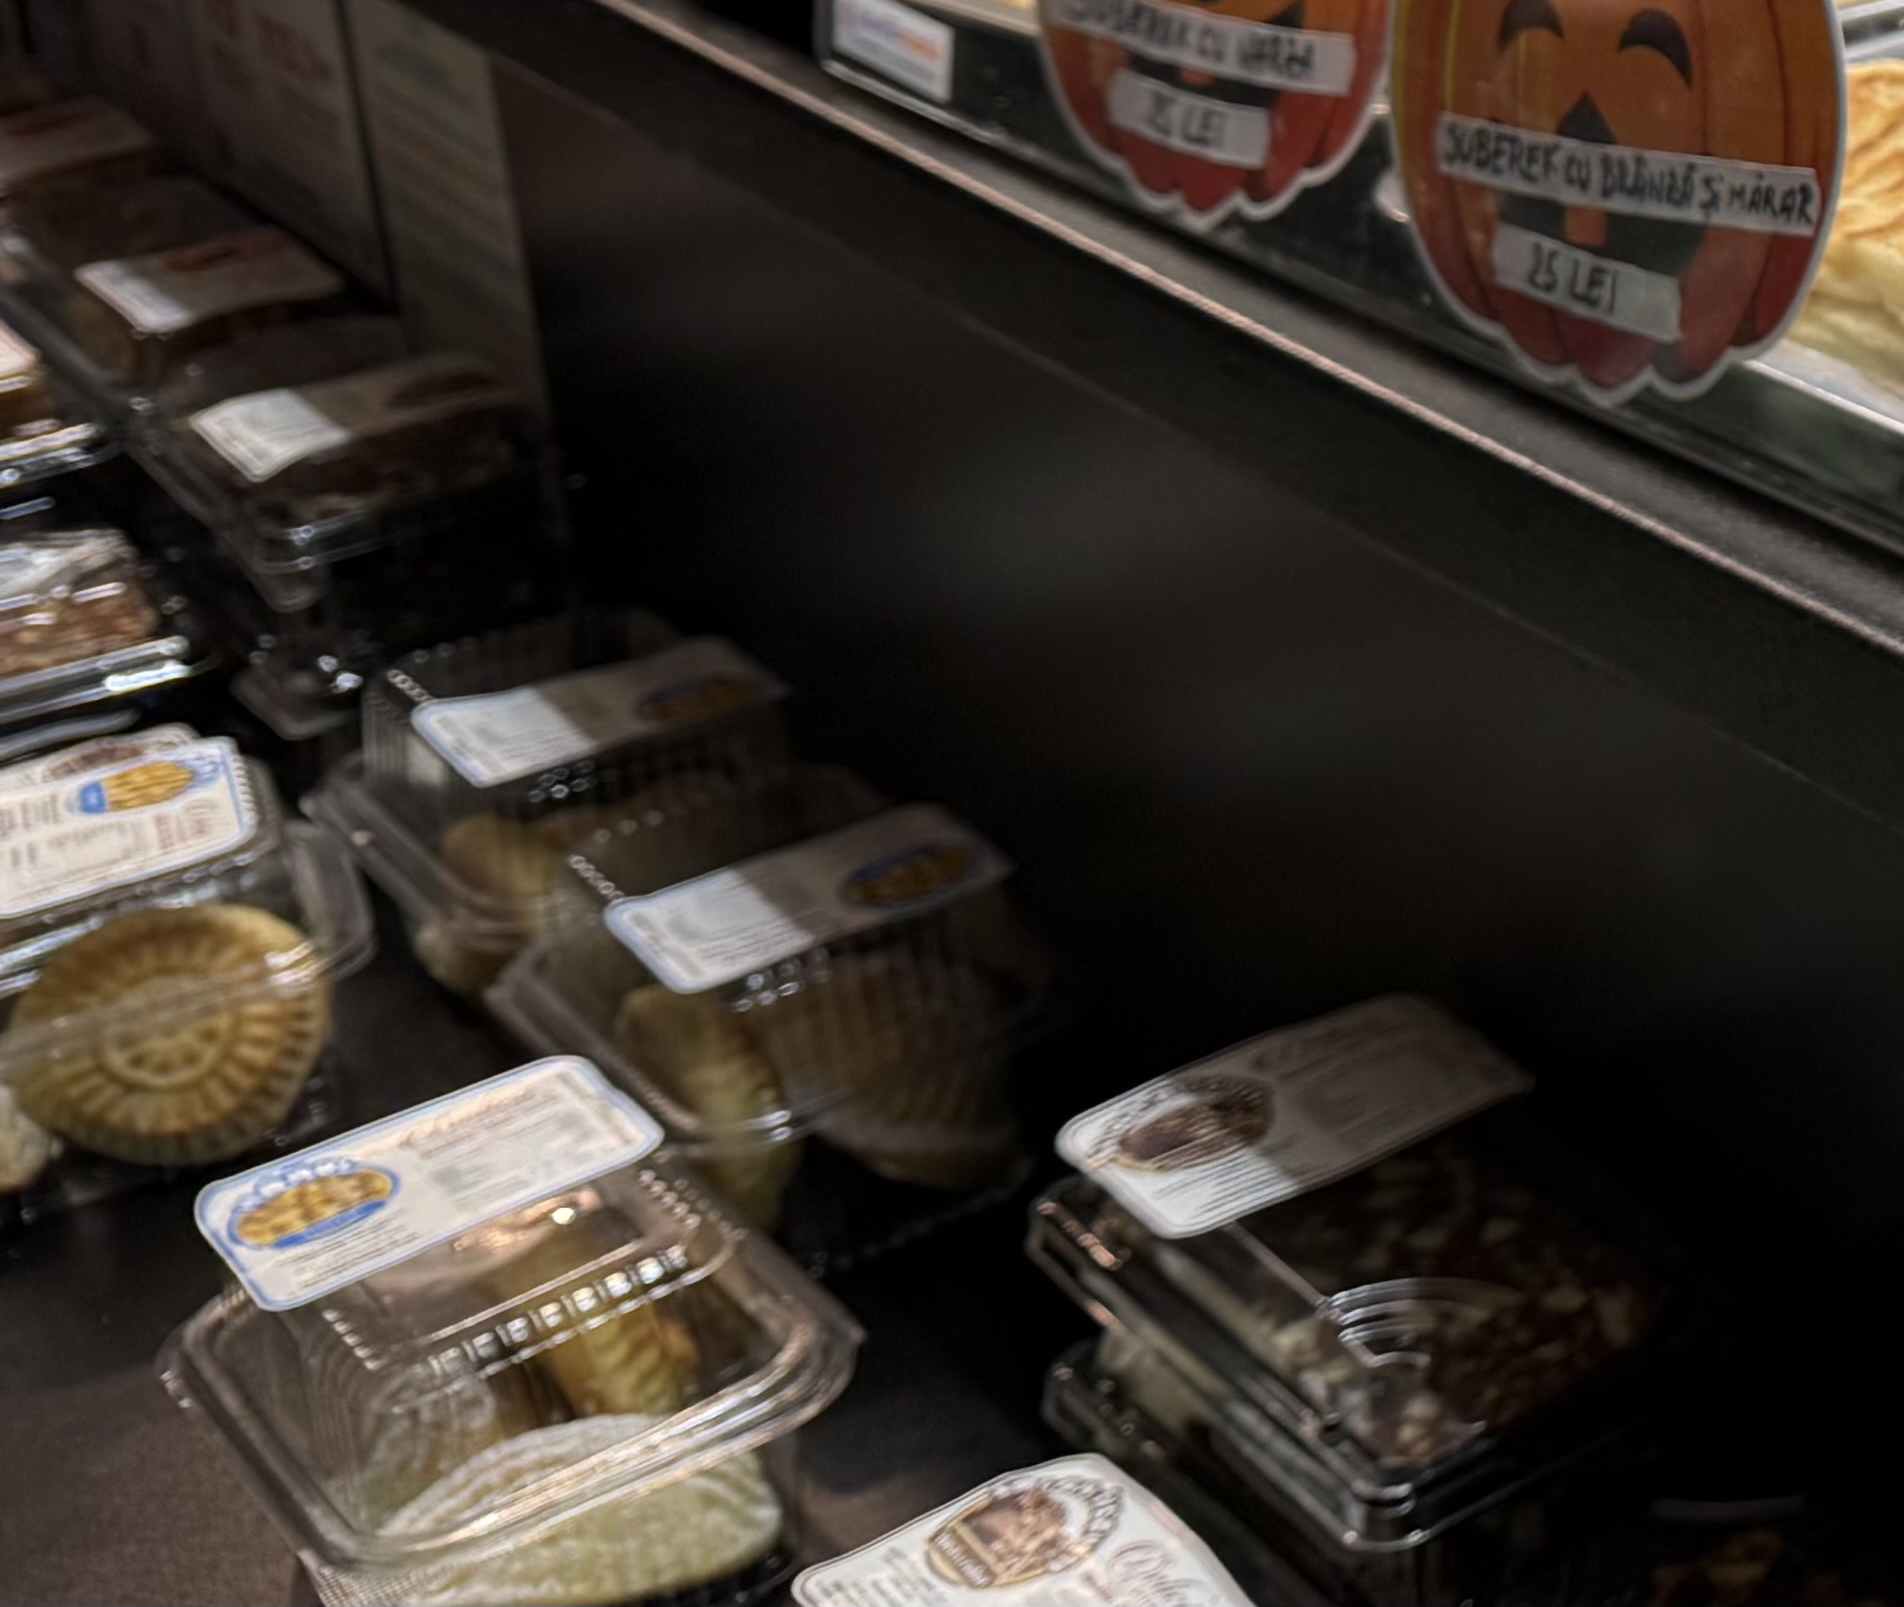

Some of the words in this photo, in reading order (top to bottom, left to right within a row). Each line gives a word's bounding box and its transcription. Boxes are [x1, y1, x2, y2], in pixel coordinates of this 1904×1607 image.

[1445, 125, 1559, 181] SUBEREK
[1564, 155, 1590, 190] CU
[1569, 257, 1619, 315] LEI
